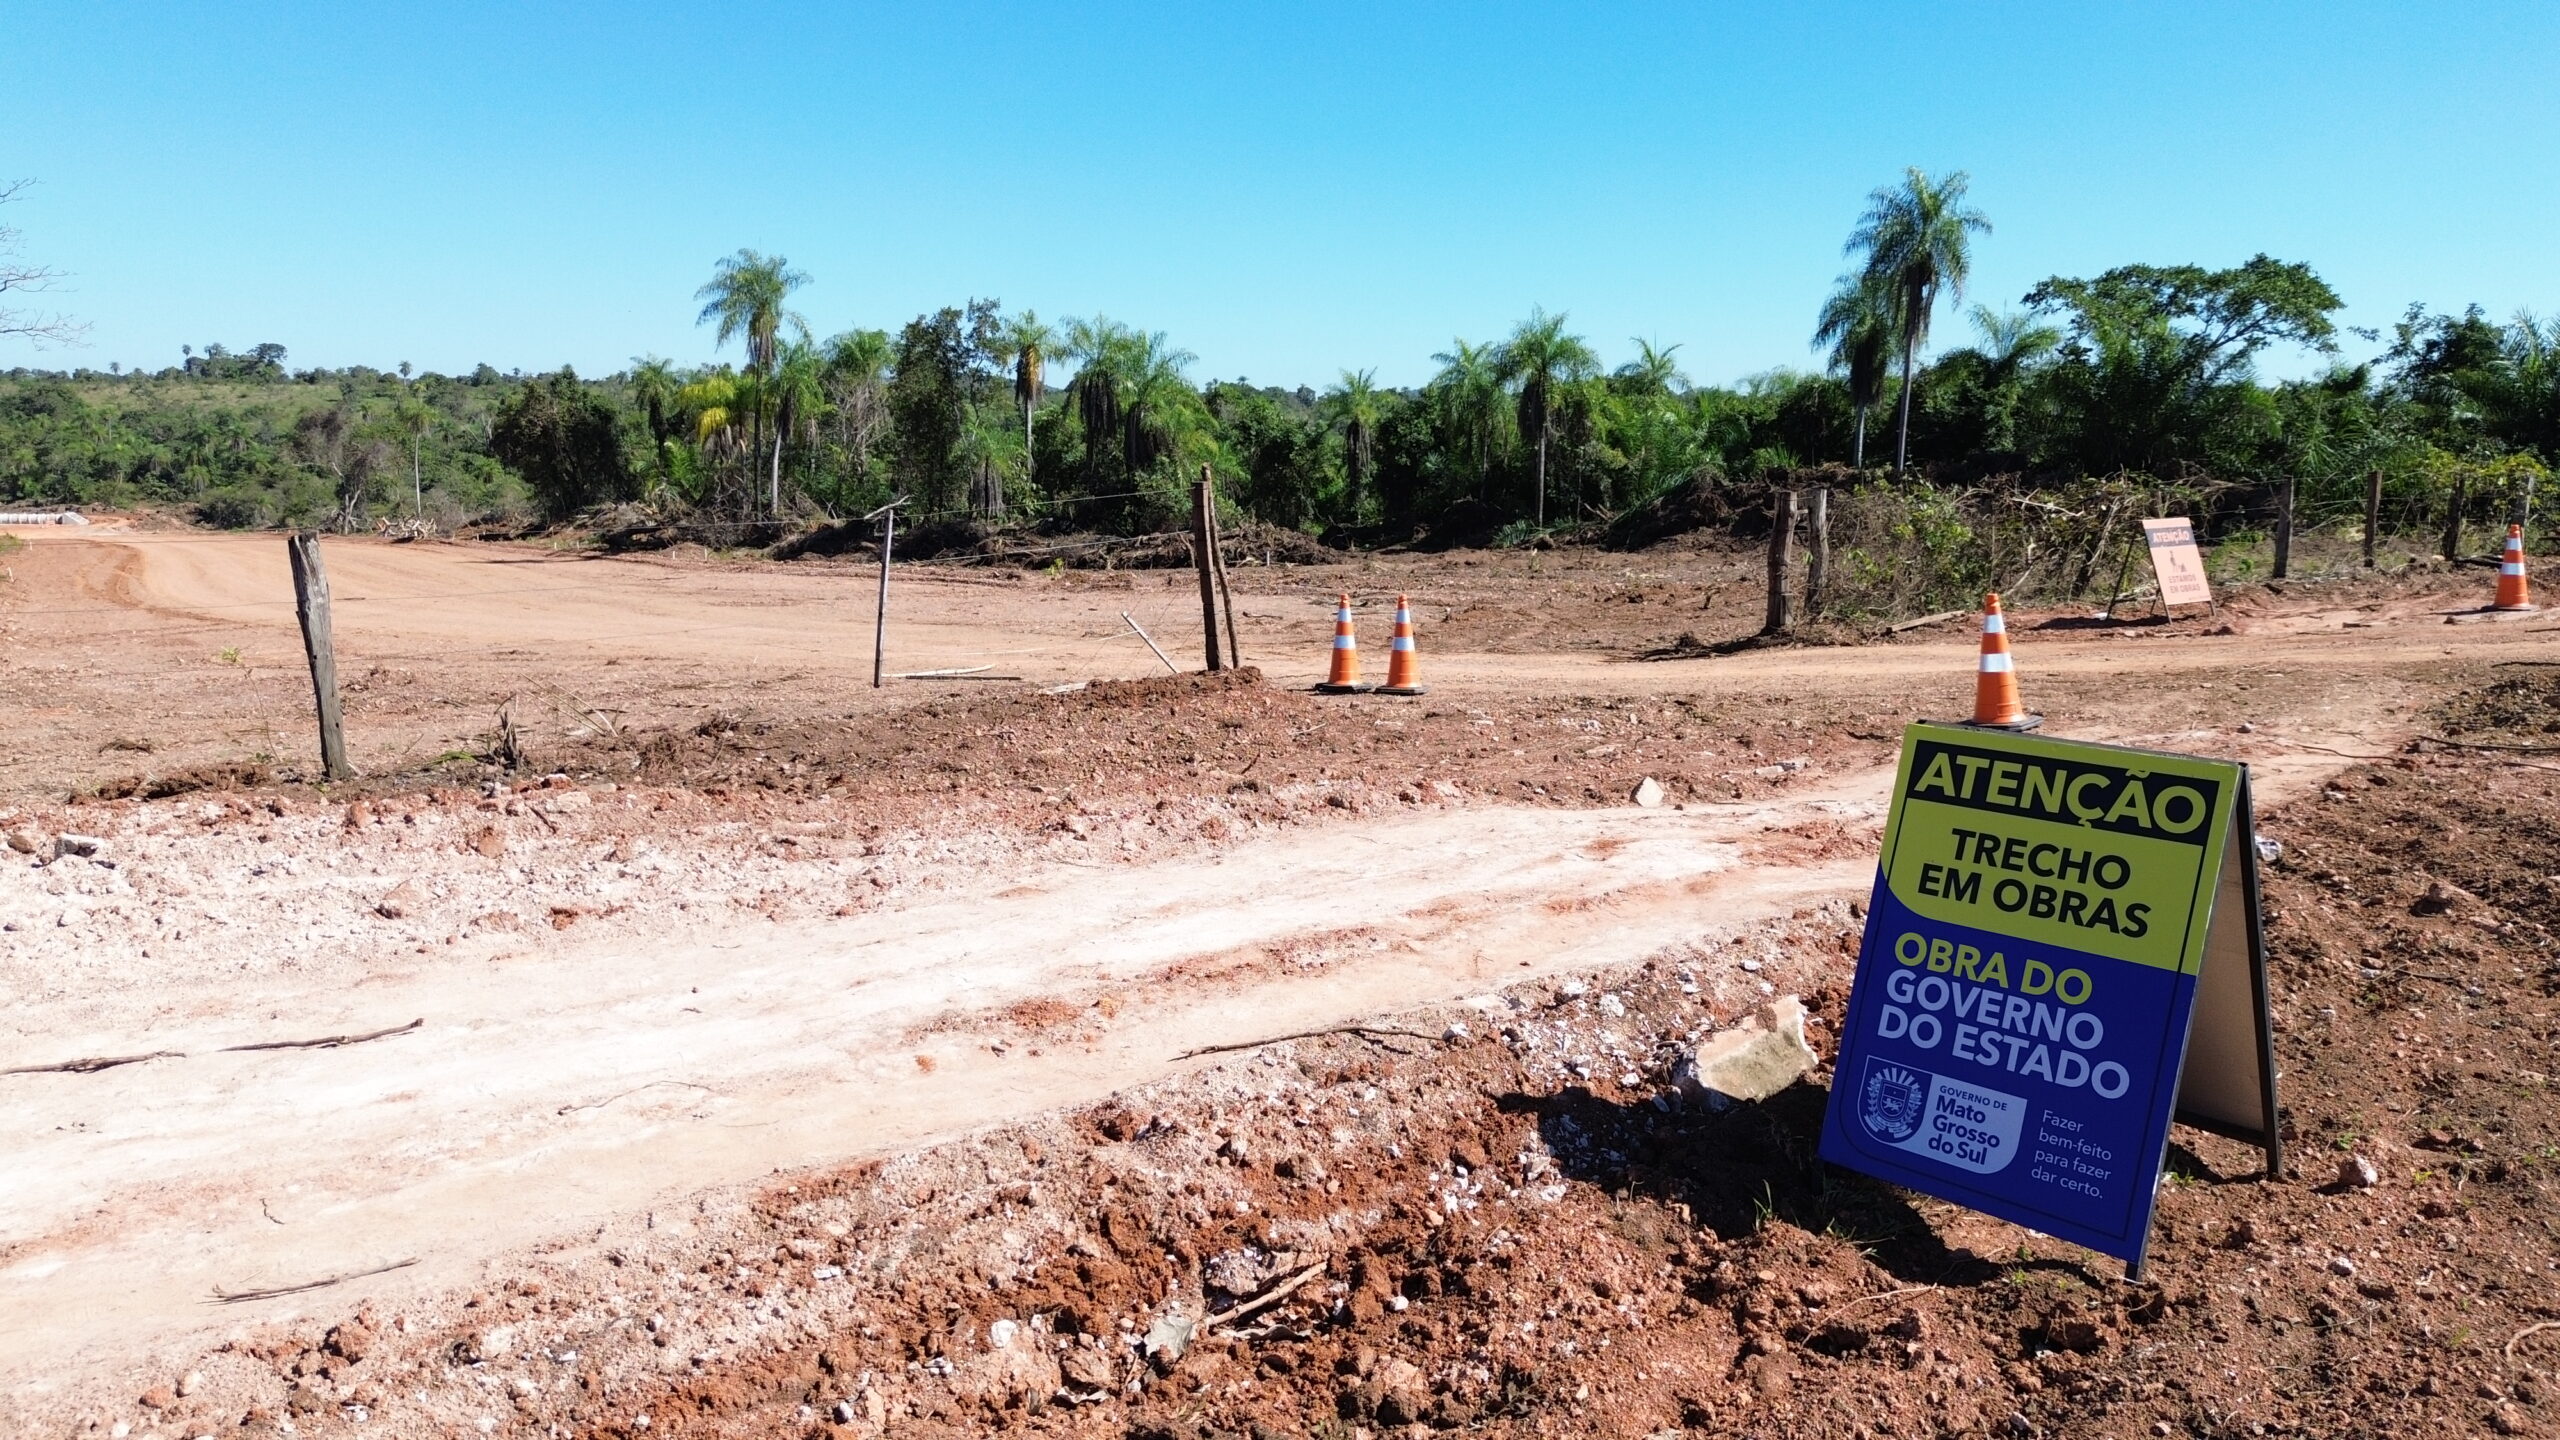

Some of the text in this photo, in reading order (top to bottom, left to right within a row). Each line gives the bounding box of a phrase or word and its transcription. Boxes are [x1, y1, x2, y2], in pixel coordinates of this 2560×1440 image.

[2153, 528, 2190, 544] ATENÇÃO
[1914, 752, 2206, 834] ATENÇÃO
[1951, 828, 2131, 890] TRECHO
[1917, 862, 2152, 938] EM OBRAS
[1894, 932, 2093, 1005] OBRA DO
[1886, 969, 2104, 1050] GOVERNO
[1877, 1004, 2130, 1099] DO ESTADO
[1935, 1094, 1986, 1124] Mato
[1939, 1085, 2008, 1111] GOVERNO DE
[1932, 1114, 2000, 1148] Grosso
[2042, 1109, 2084, 1133] Fazer
[1928, 1134, 1988, 1165] do Sul
[2038, 1128, 2112, 1161] bem-feito
[2034, 1149, 2112, 1180] para fazer
[2031, 1166, 2103, 1199] dar certo.
